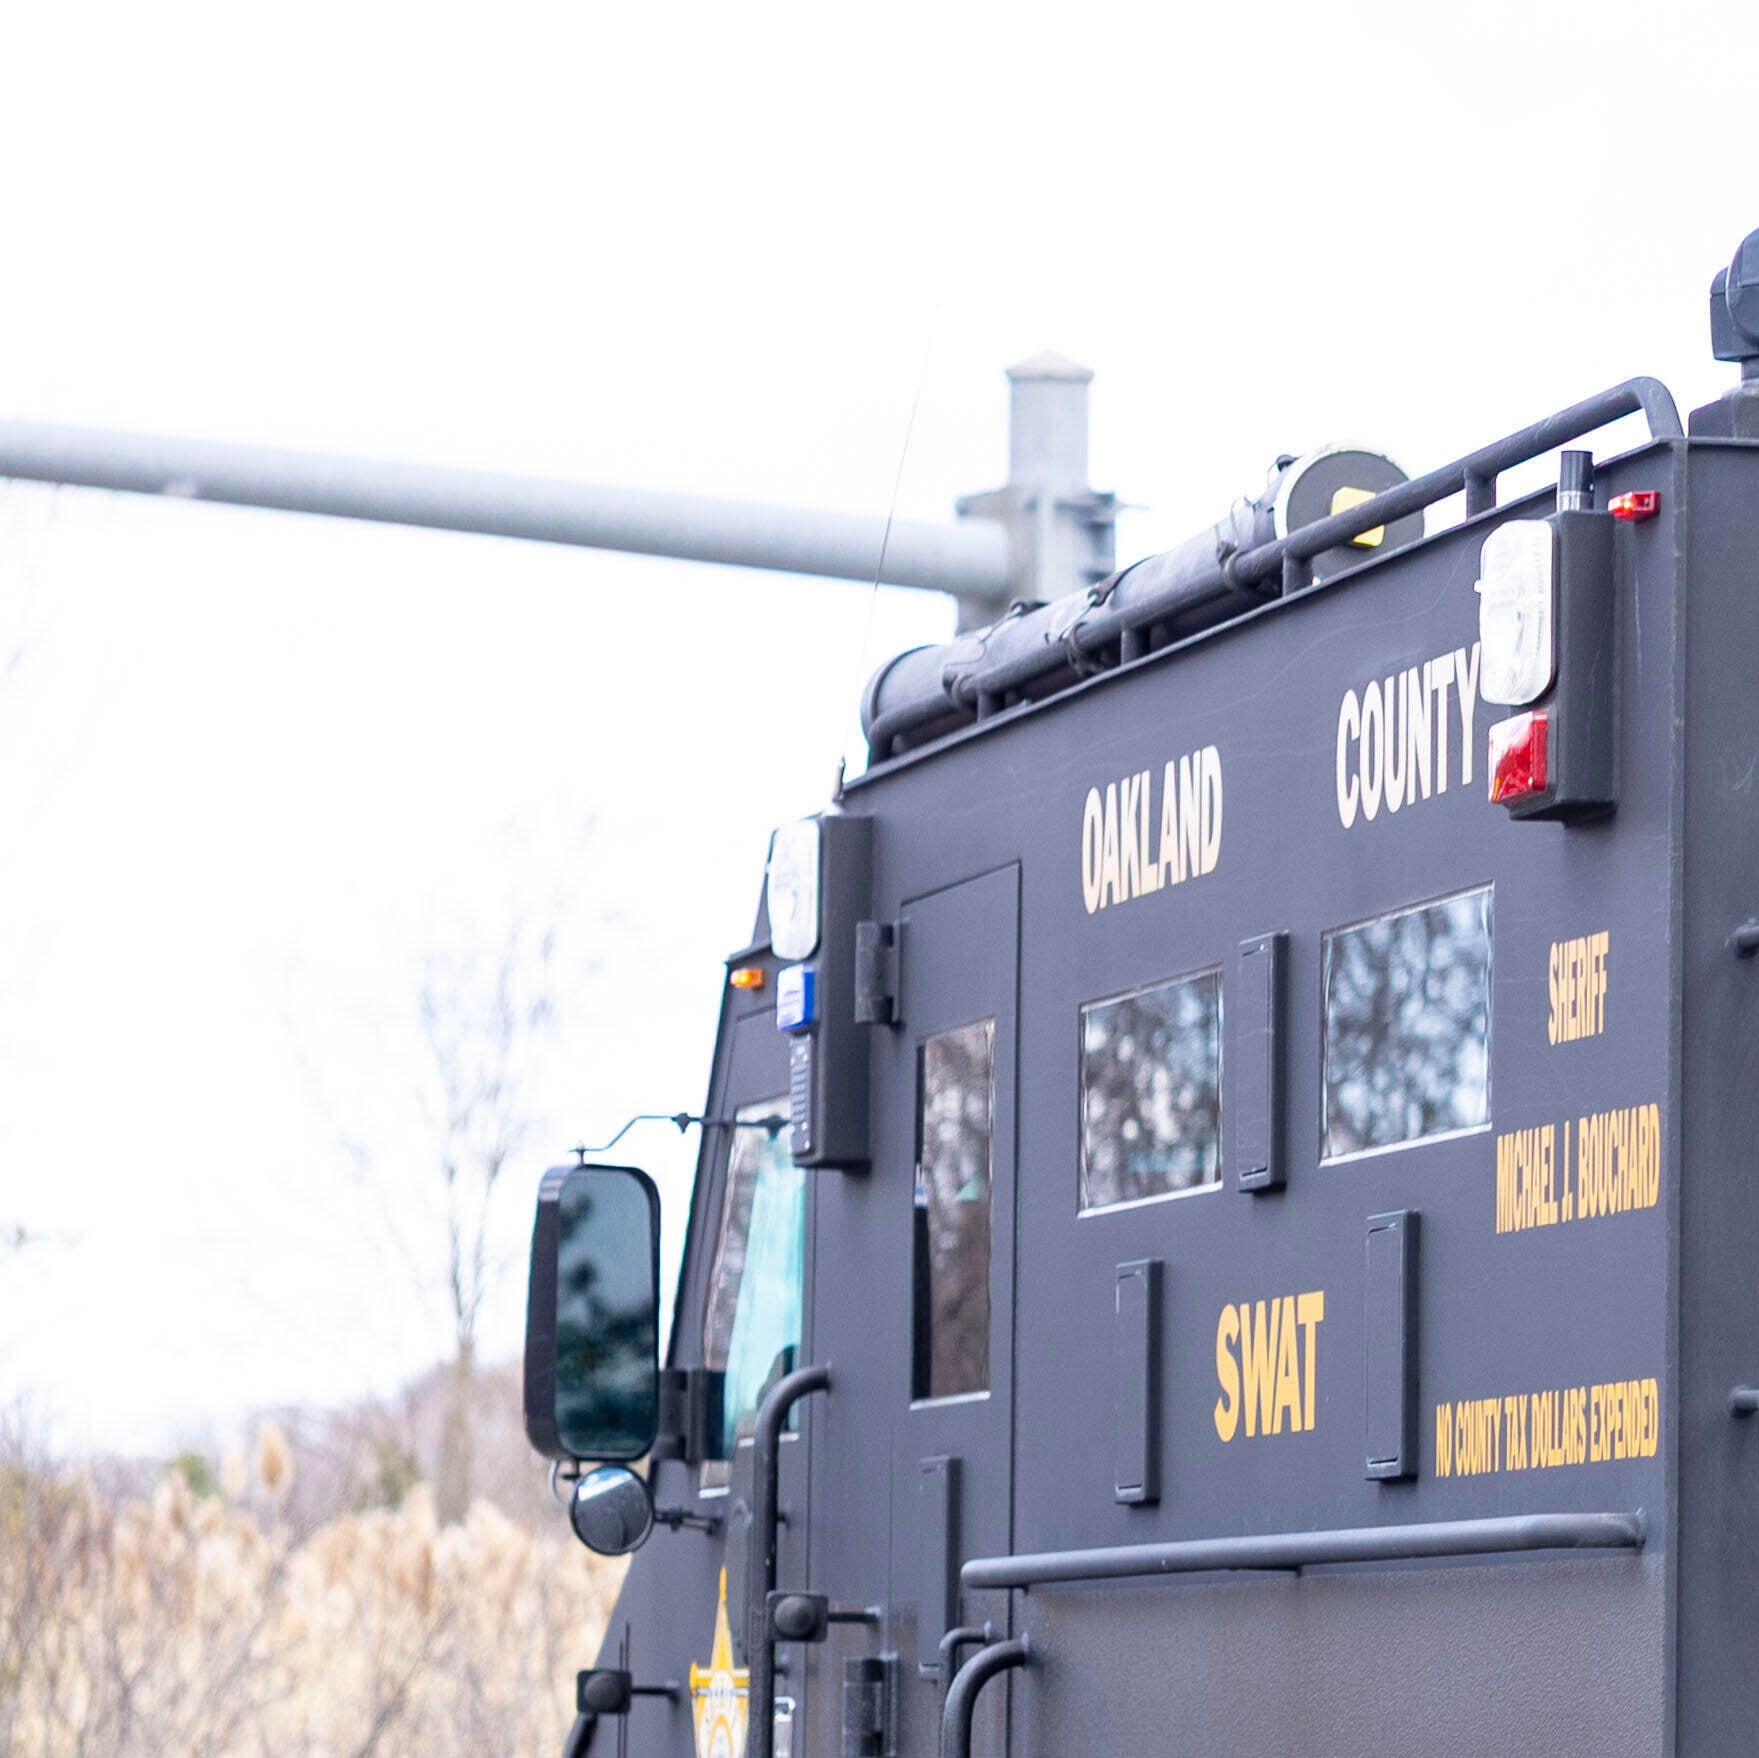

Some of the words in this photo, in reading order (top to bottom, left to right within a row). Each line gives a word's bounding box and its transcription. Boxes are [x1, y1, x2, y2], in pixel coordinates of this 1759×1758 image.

[1082, 745, 1223, 914] OAKLAND
[1335, 642, 1481, 829] COUNTY
[1547, 931, 1609, 1046] SHERIFF
[1496, 1123, 1558, 1235] MICHAEL
[1562, 1119, 1573, 1224] J.
[1577, 1103, 1661, 1220] BOUCHARD
[1213, 1290, 1324, 1443] SWAT
[1435, 1402, 1453, 1478] NO
[1455, 1397, 1502, 1477] COUNTY
[1504, 1394, 1528, 1472] TAX
[1530, 1386, 1587, 1469] DOLLARS
[1590, 1377, 1659, 1462] EXPENDED
